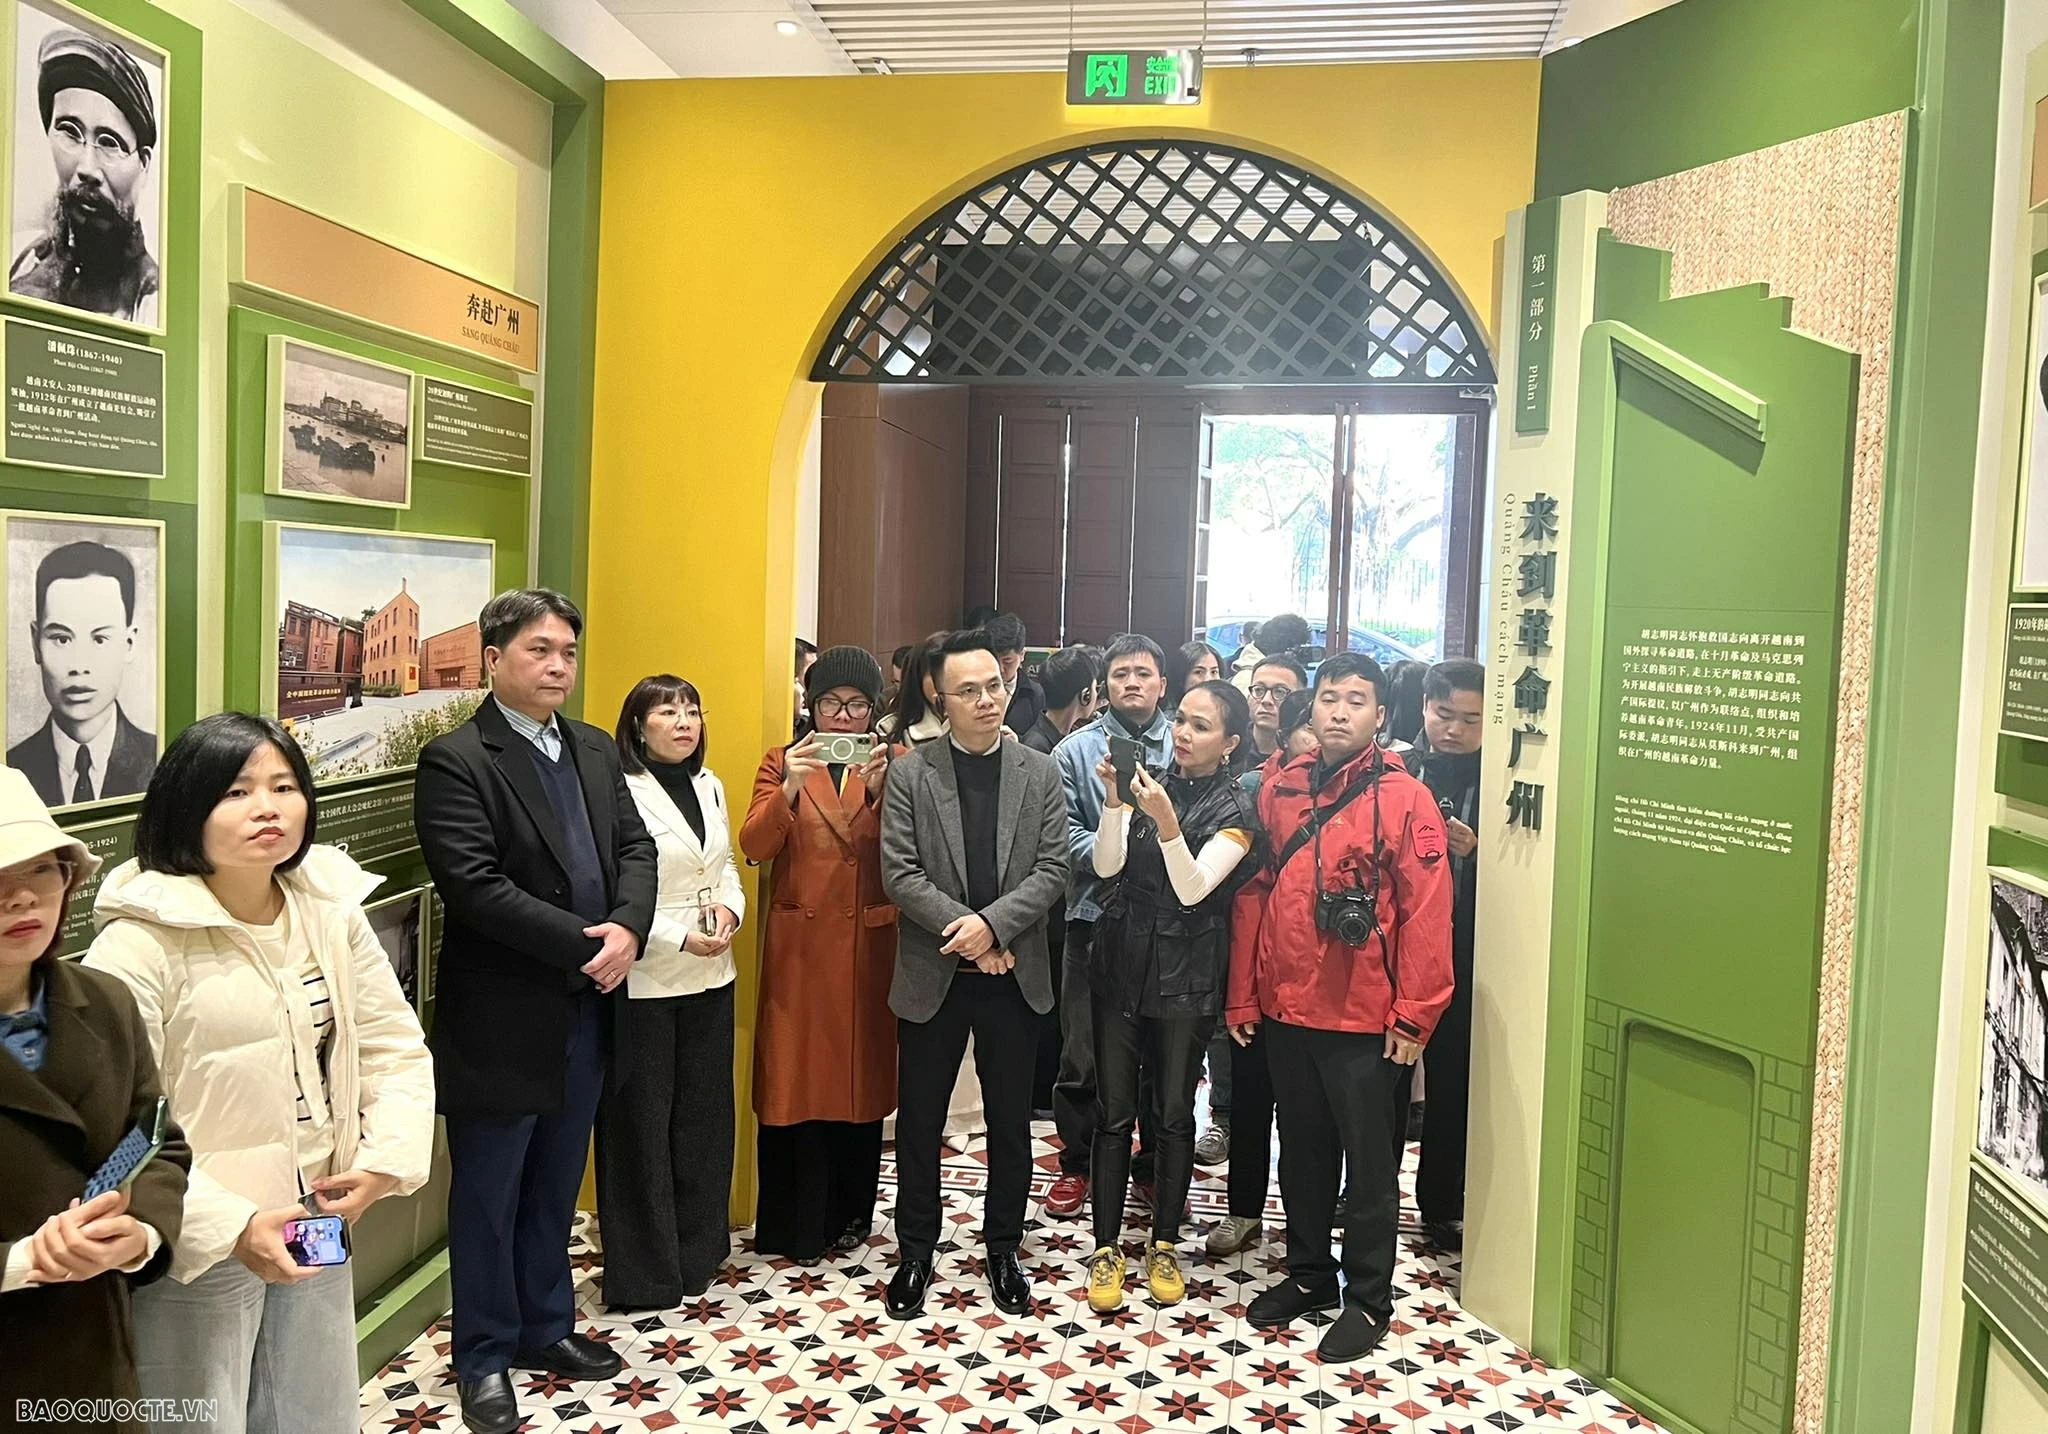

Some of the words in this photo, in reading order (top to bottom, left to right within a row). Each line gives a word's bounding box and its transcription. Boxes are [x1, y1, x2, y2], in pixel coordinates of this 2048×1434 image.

[467, 292, 520, 335] 奔赴广州
[1528, 253, 1547, 342] 第一部分
[461, 326, 480, 341] SANG
[1501, 493, 1515, 554] Quảng
[1501, 564, 1512, 611] Châu
[1498, 620, 1509, 664] cách
[1506, 492, 1559, 830] 来到革命广州
[1493, 674, 1505, 724] mạng
